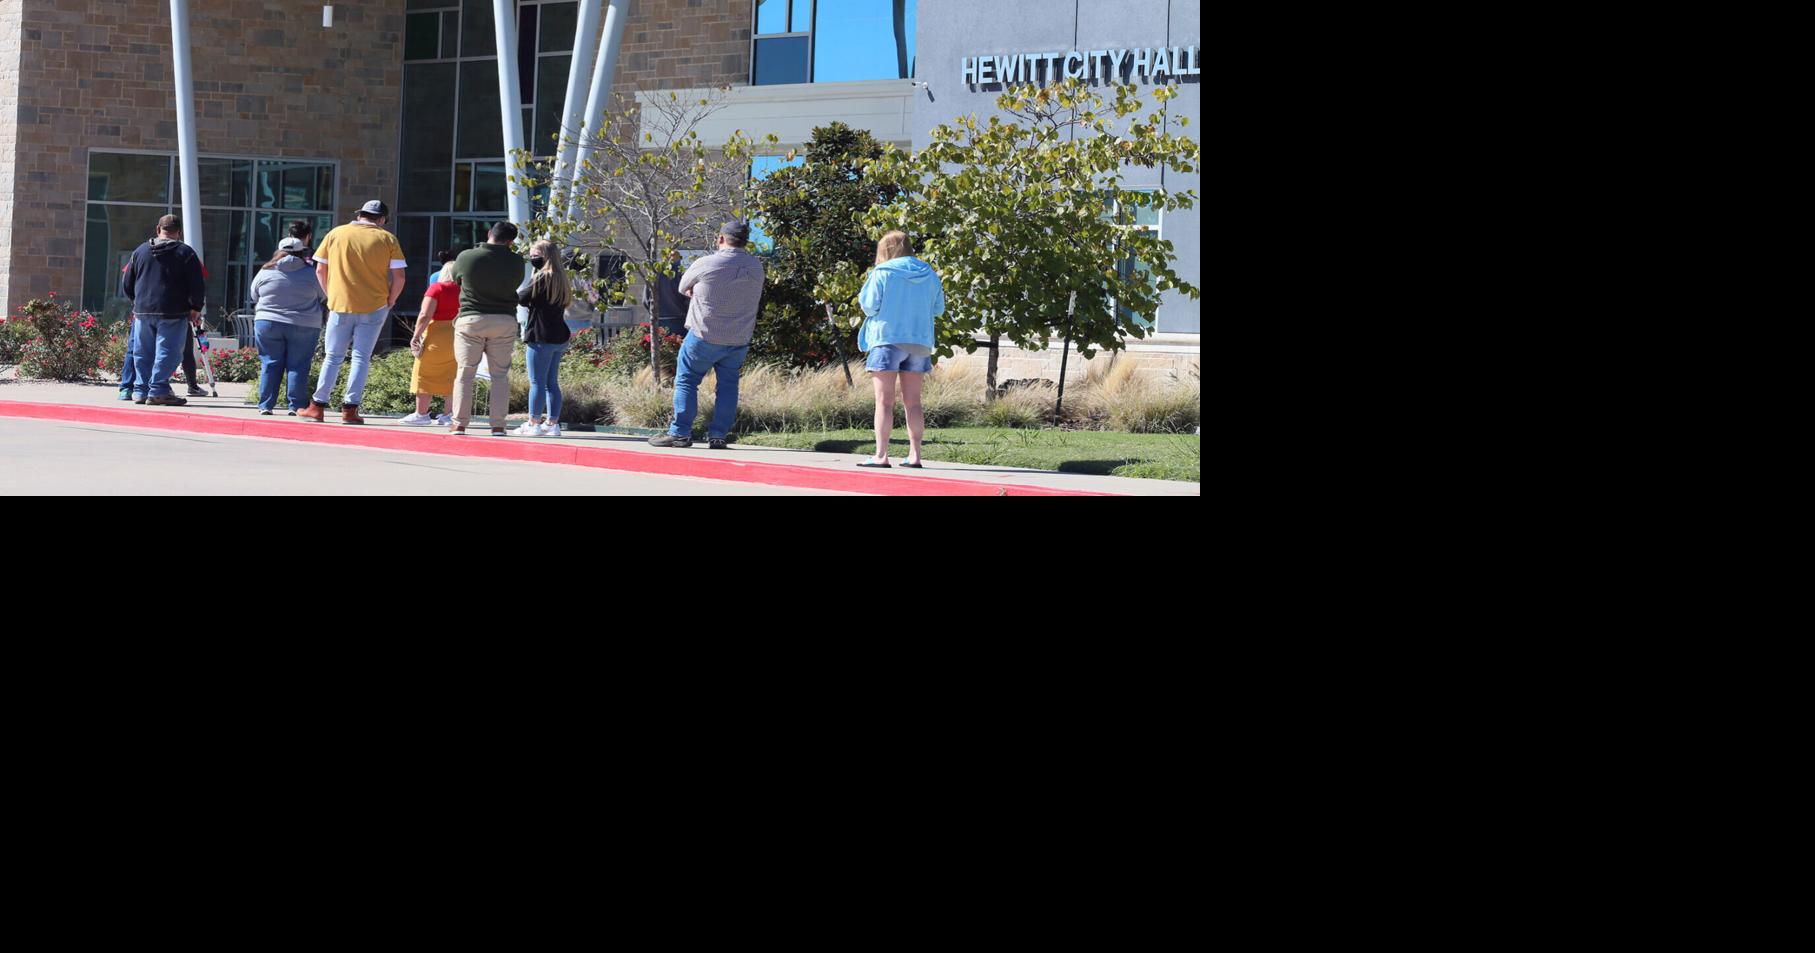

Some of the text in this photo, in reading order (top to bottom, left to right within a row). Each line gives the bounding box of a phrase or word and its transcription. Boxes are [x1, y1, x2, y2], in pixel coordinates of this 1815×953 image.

[961, 46, 1200, 84] HEWITT CITY HALL
